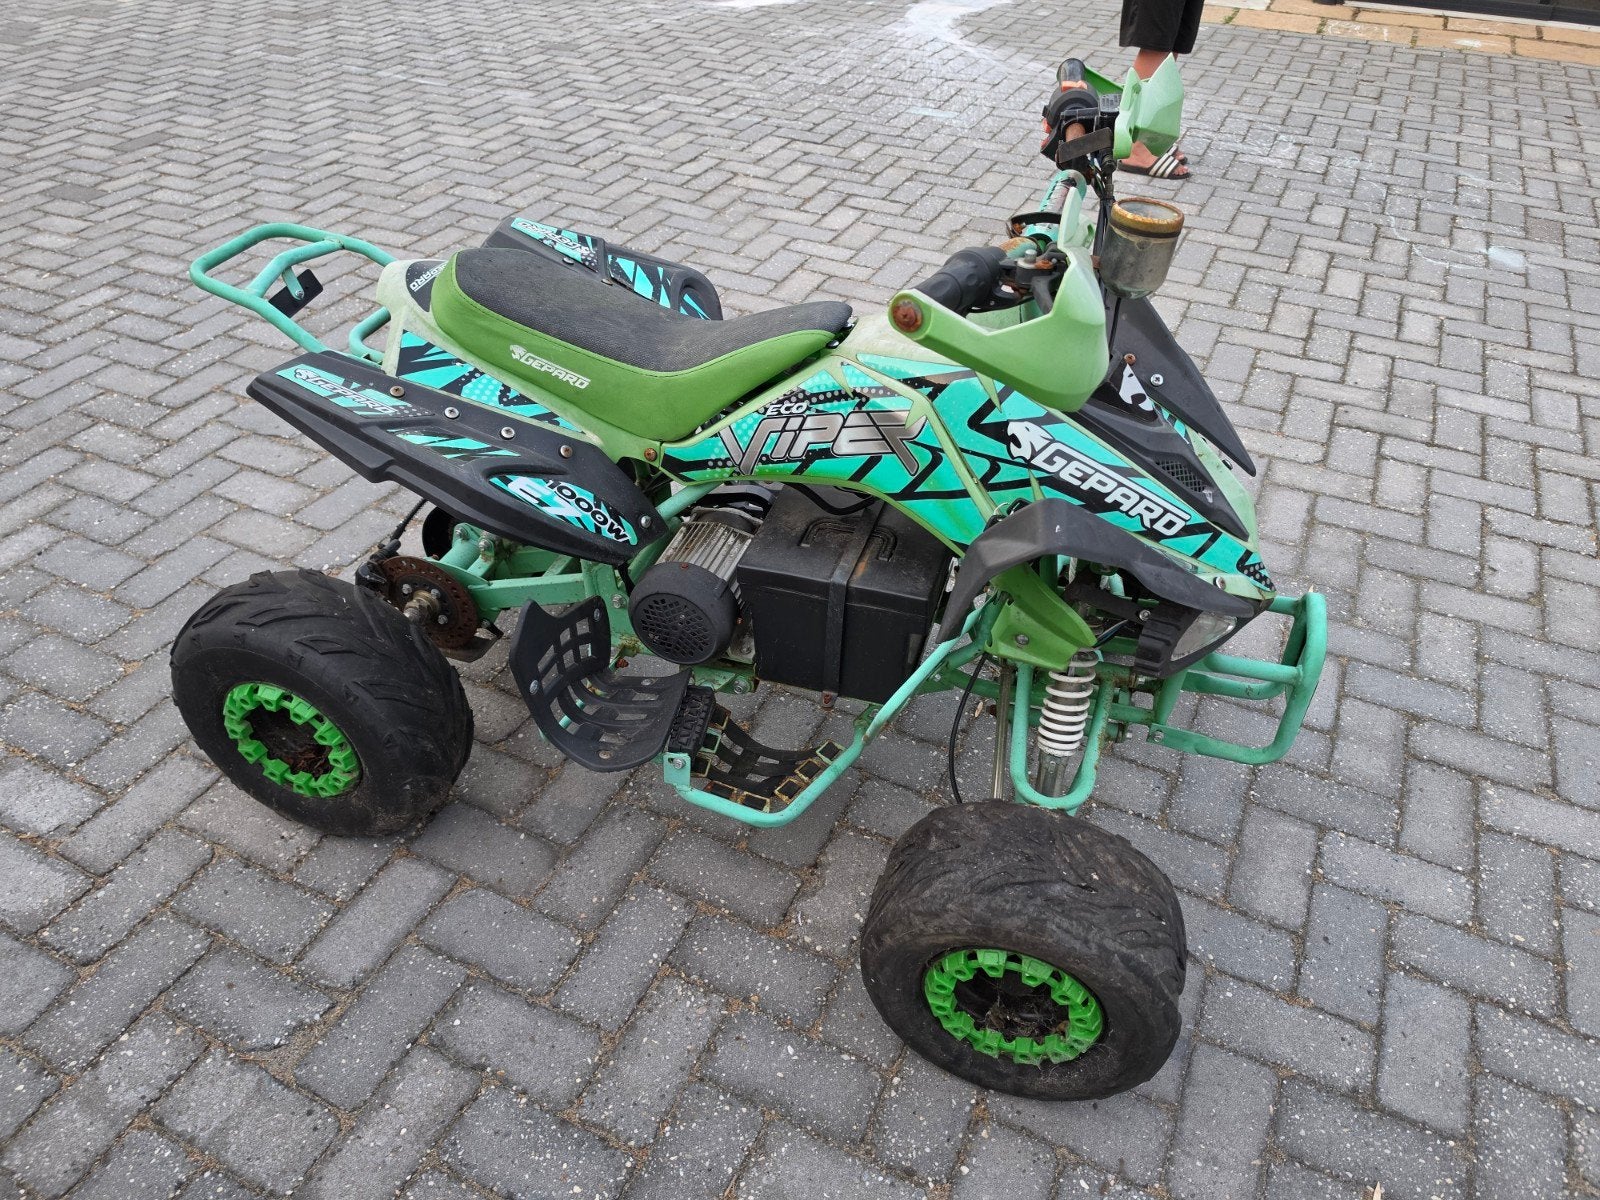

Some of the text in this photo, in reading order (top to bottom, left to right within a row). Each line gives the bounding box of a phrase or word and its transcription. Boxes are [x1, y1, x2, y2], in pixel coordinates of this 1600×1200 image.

[520, 352, 591, 389] GEPARD
[312, 376, 398, 413] GEPARD
[766, 402, 809, 416] ECO
[1031, 443, 1191, 536] GEPARD
[546, 479, 629, 542] 1000W
